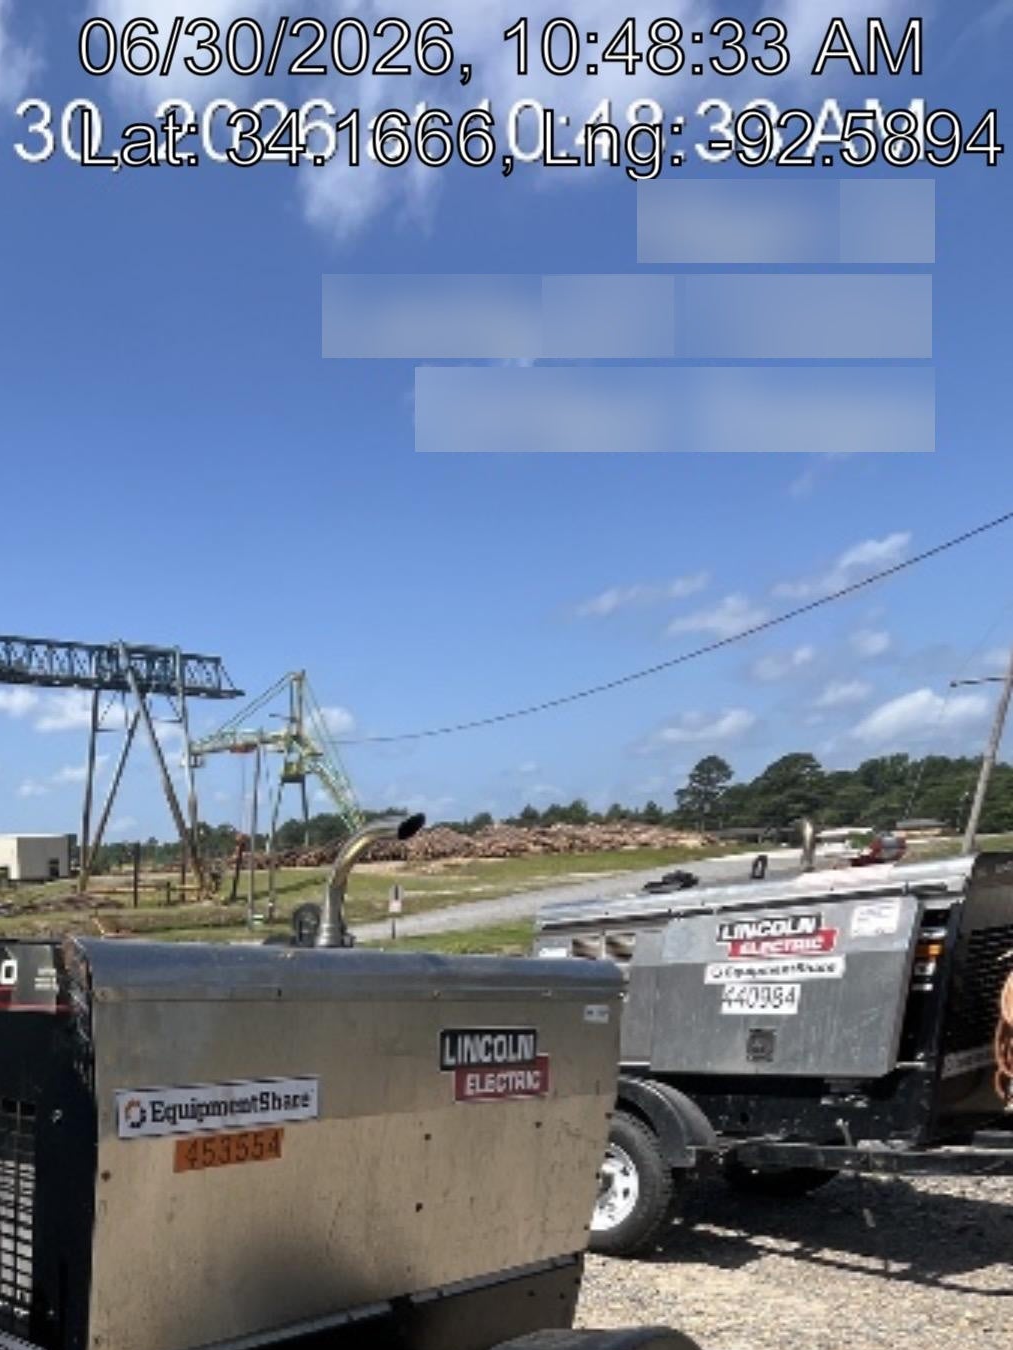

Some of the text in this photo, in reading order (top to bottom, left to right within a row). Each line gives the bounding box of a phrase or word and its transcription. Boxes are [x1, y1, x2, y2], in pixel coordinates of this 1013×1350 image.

[722, 916, 816, 941] LINCOLN
[740, 937, 825, 956] ELECTRIC
[444, 1033, 535, 1066] LINCOLN
[464, 1069, 542, 1096] ELECTRIC
[150, 1090, 311, 1125] EquipmentShare
